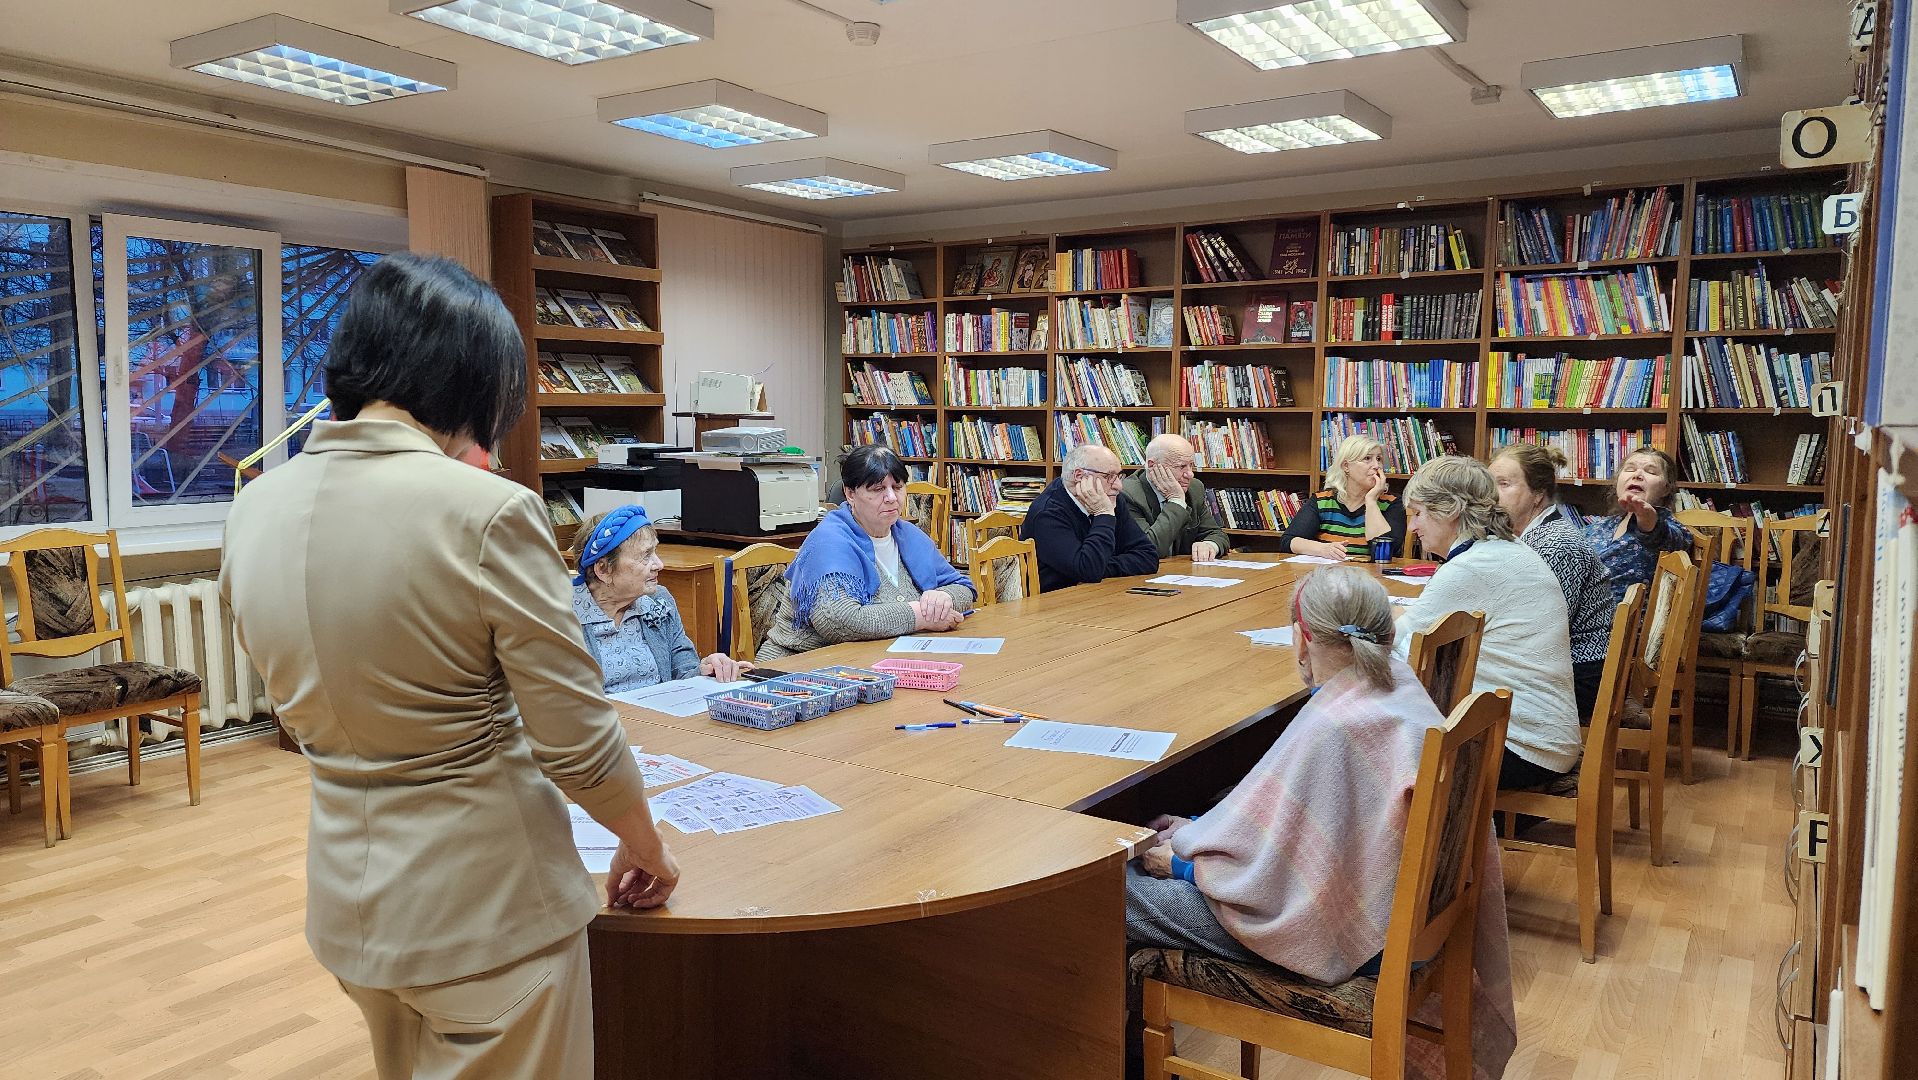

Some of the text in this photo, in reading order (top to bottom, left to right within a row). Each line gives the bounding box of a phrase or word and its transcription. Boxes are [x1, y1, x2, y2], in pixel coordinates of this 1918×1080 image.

[1791, 116, 1838, 159] О
[1833, 198, 1858, 229] Б
[1817, 386, 1838, 413] П
